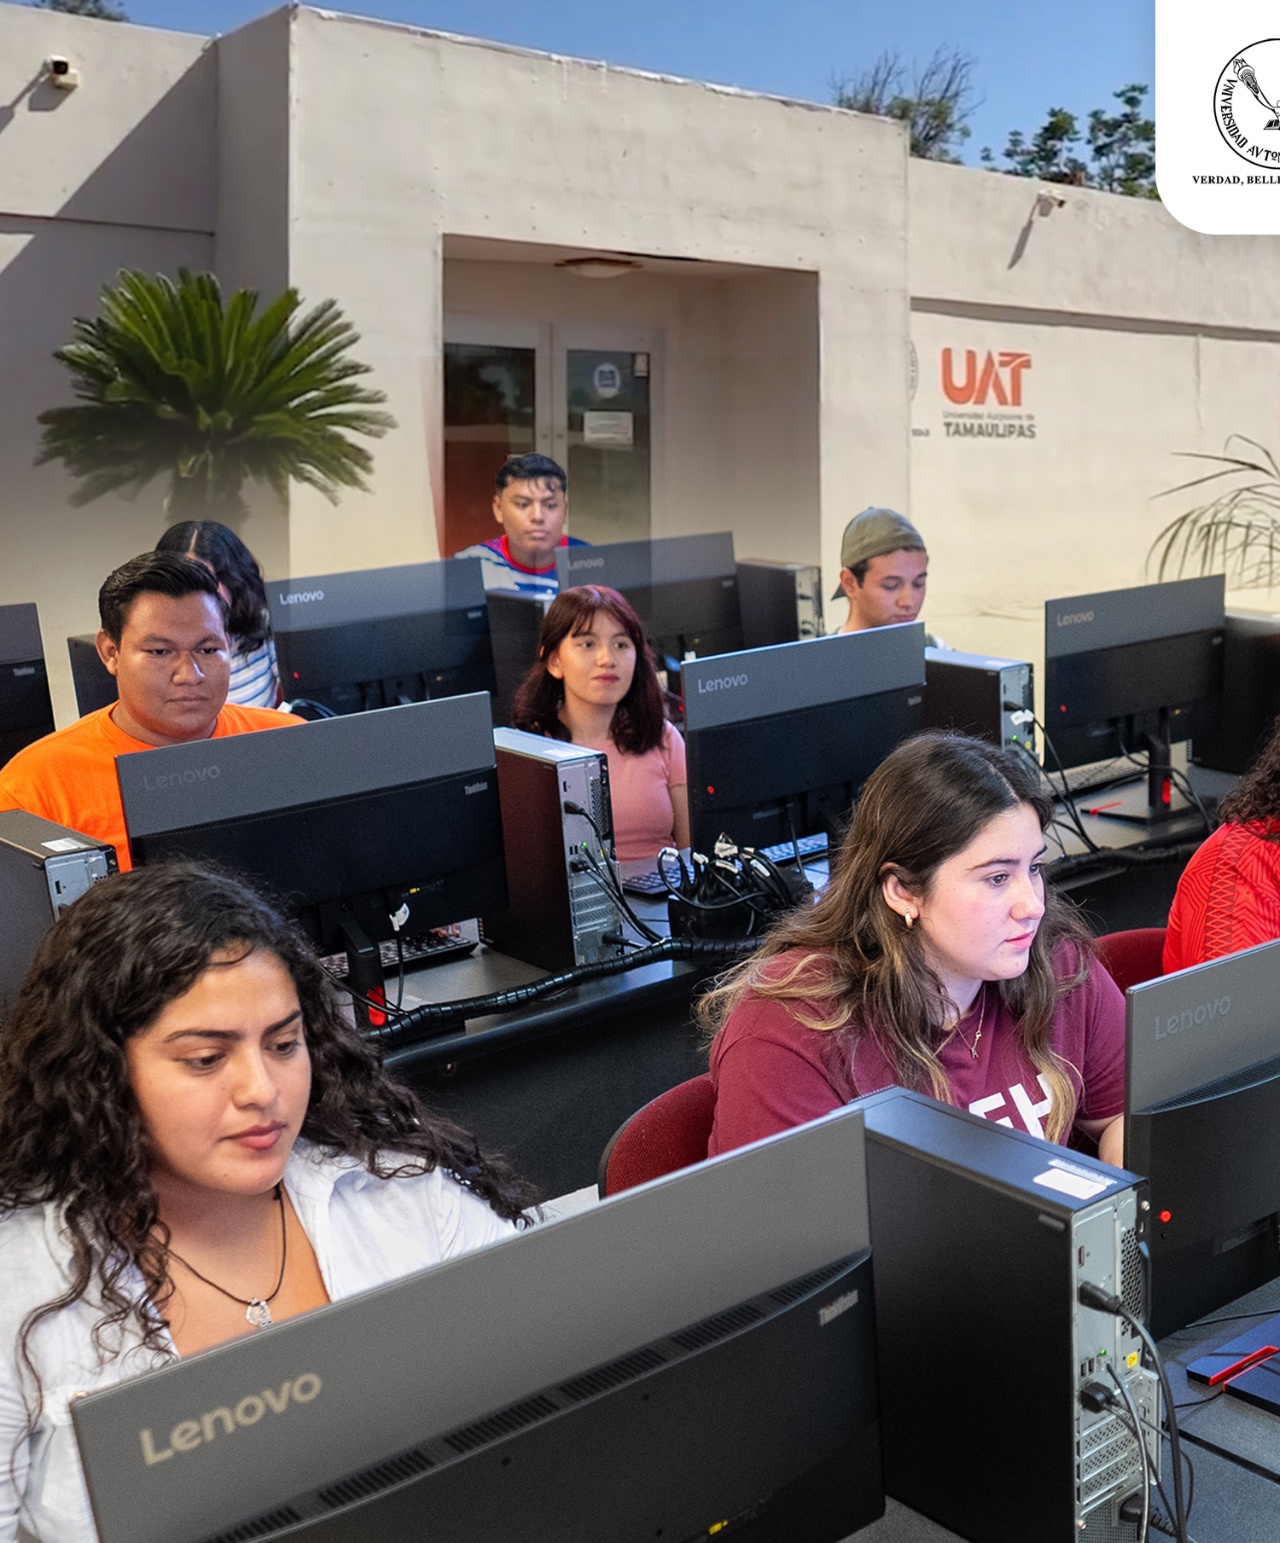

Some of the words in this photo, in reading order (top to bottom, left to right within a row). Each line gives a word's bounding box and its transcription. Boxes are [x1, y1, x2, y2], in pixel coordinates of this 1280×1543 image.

[941, 347, 1032, 407] UAT
[943, 421, 1036, 439] TAMAULIPAS
[567, 557, 605, 571] Lenovo
[279, 589, 325, 606] Lenovo
[1056, 610, 1096, 627] Lenovo
[697, 673, 749, 694] Lenovo
[143, 765, 221, 791] Lenovo
[1154, 995, 1232, 1042] Lenovo
[139, 1371, 323, 1467] Lenovo
